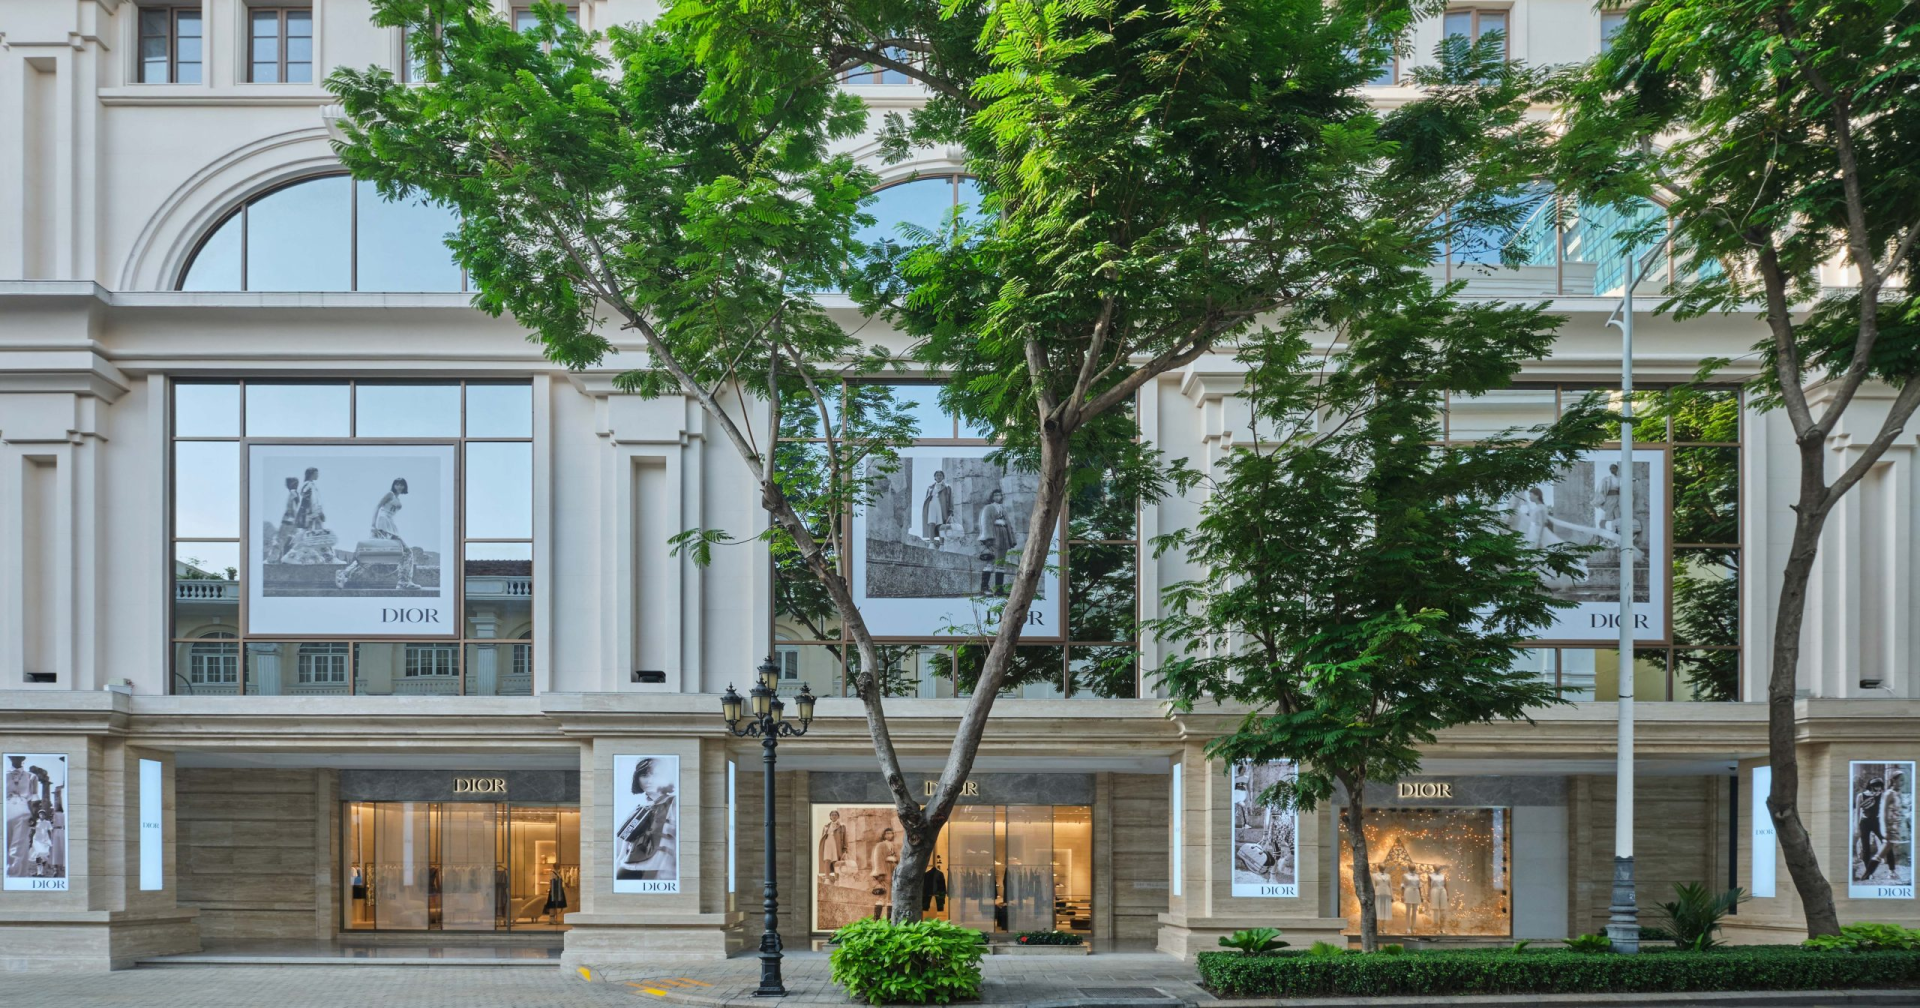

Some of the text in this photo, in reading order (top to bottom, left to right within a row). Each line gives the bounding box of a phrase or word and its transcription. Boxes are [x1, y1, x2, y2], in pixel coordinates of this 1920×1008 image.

[381, 608, 440, 623] DIOR
[1590, 613, 1650, 629] DIR
[454, 778, 505, 793] DIOR
[1399, 783, 1452, 797] DIOR
[32, 879, 66, 889] DIOR
[642, 882, 677, 892] DIOR
[1261, 885, 1295, 896] DIOR
[1878, 887, 1912, 897] DIOR
